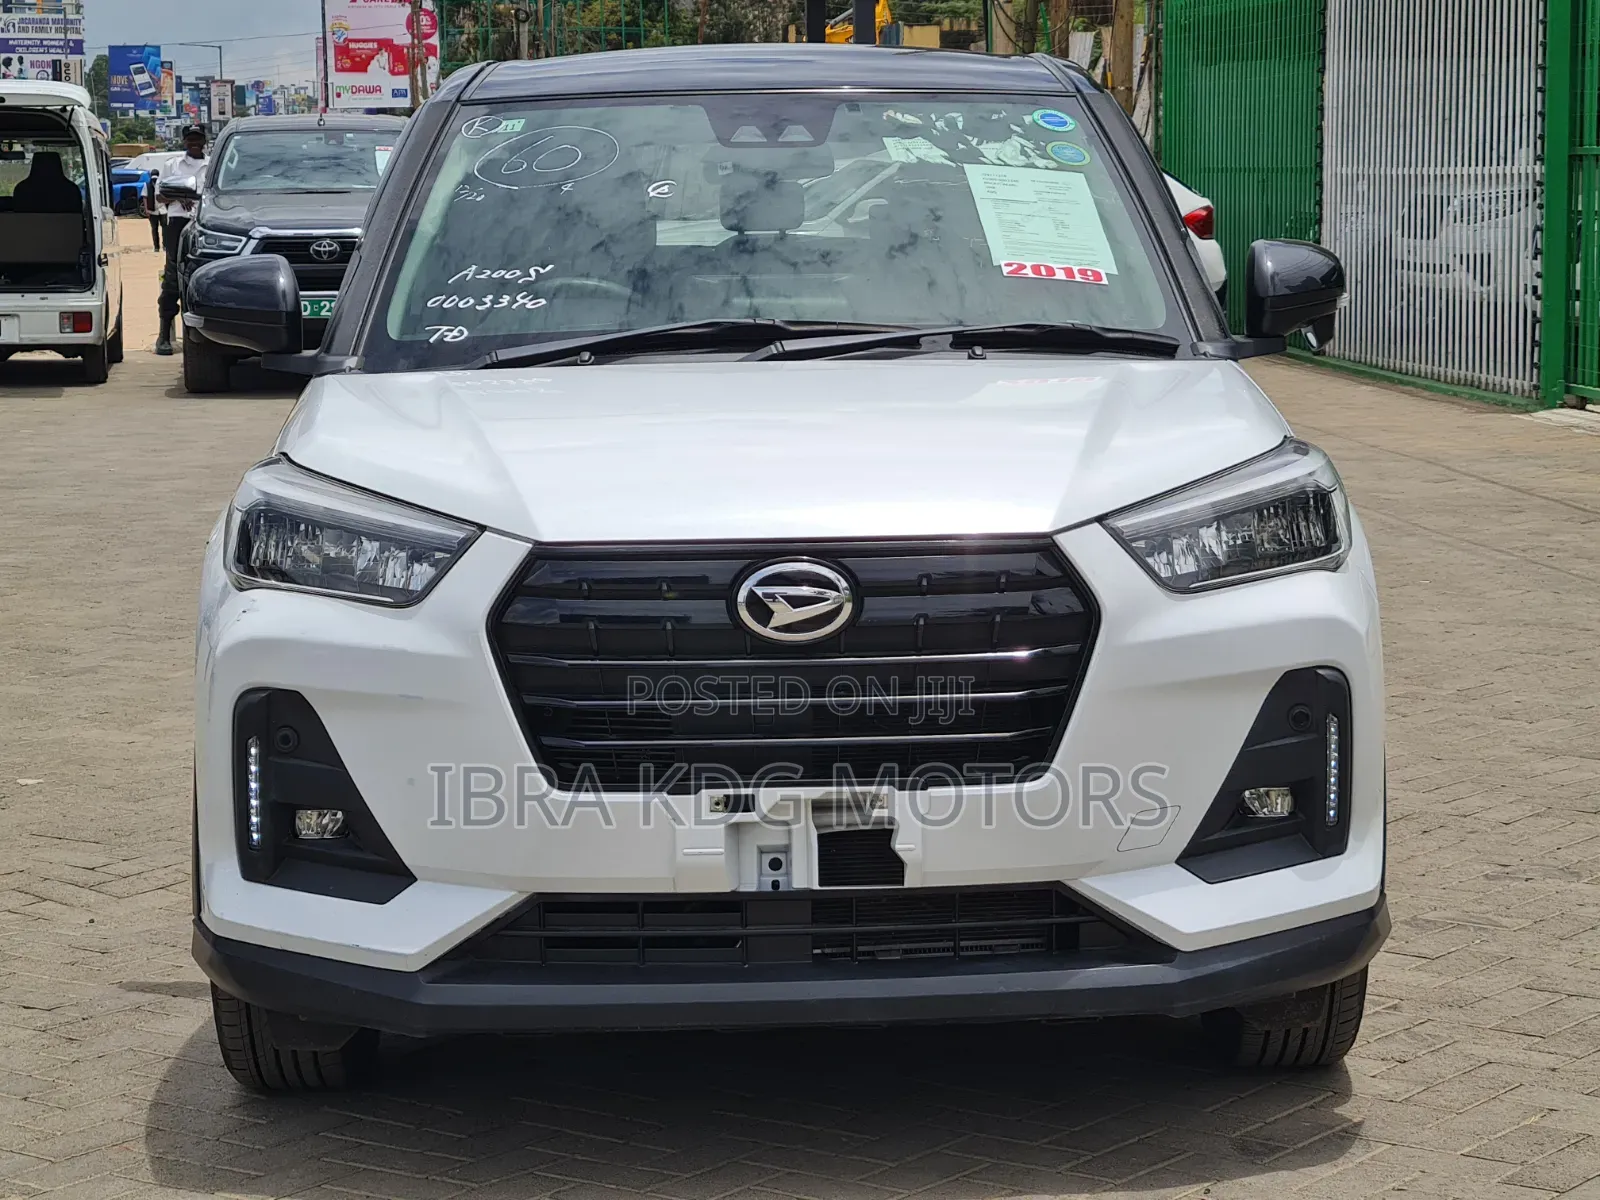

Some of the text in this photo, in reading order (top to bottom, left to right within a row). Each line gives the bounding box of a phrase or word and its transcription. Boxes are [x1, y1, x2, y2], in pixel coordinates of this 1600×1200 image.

[18, 17, 82, 26] JACARANDA MATRNITY
[17, 25, 30, 33] AND
[31, 26, 52, 34] FAMILY
[348, 41, 378, 49] HUGGIES
[110, 75, 129, 85] MOVE
[501, 135, 582, 174] 60
[1003, 262, 1104, 283] 2019
[426, 291, 547, 311] 0003340
